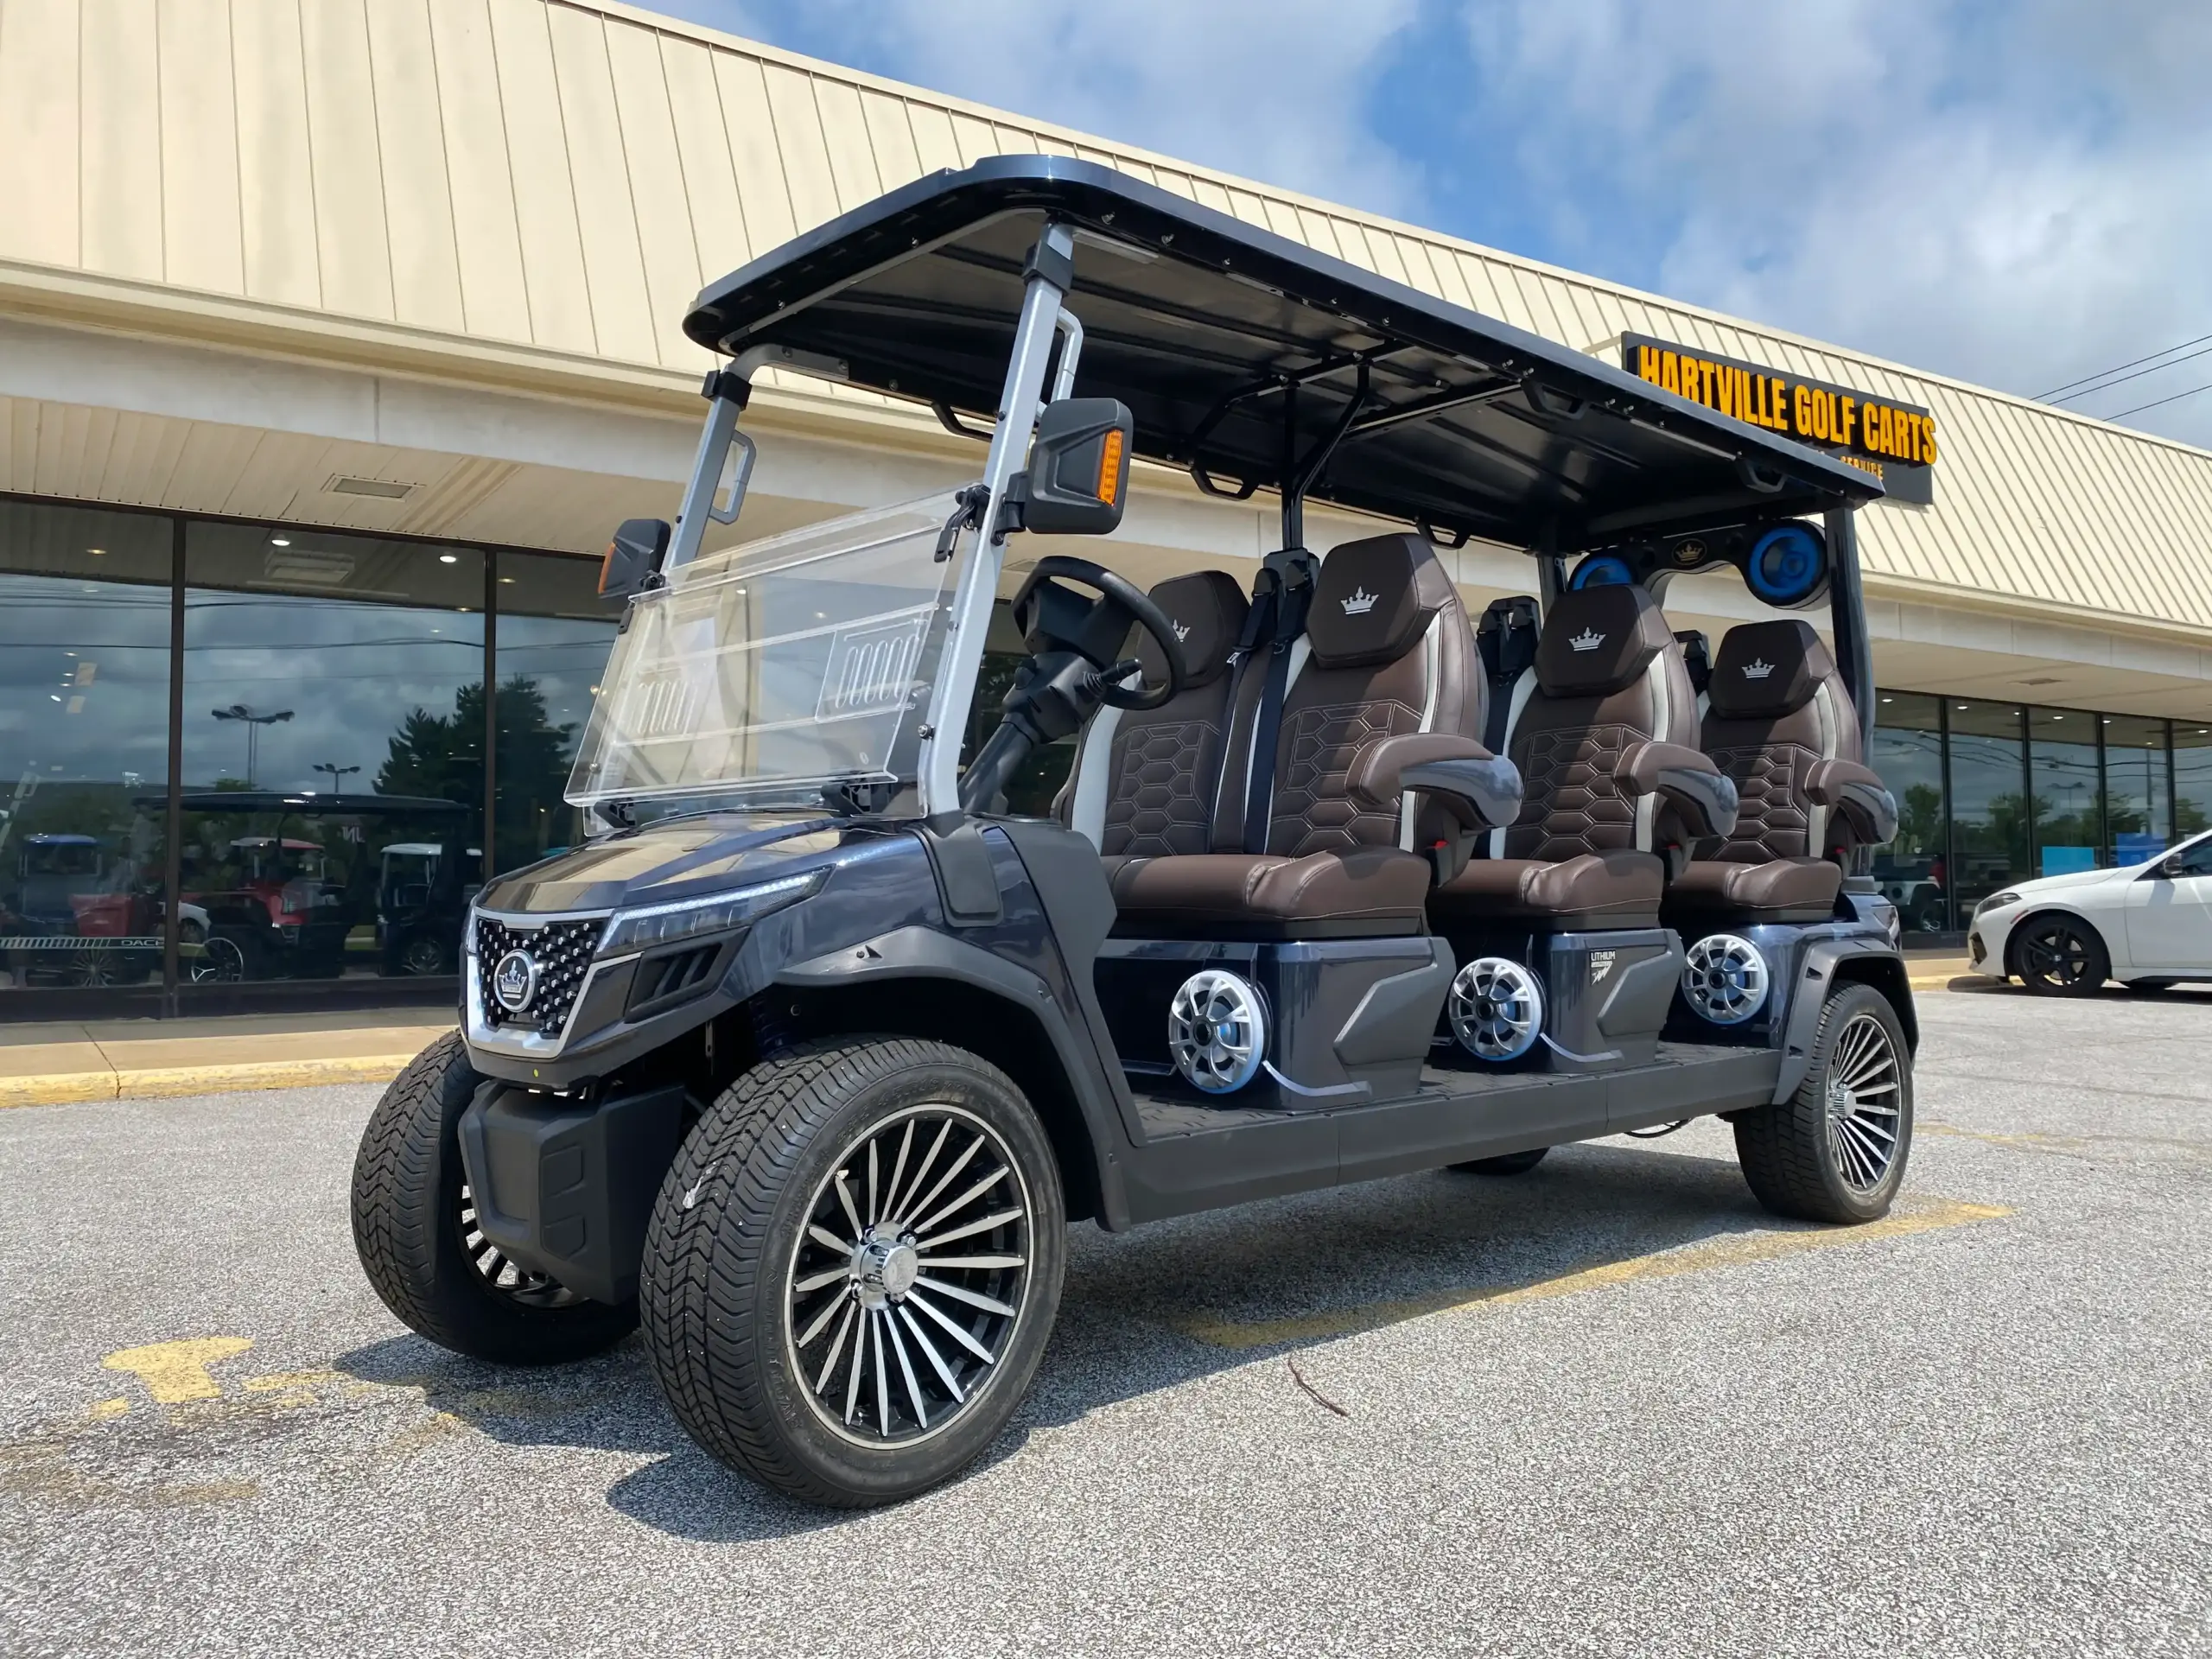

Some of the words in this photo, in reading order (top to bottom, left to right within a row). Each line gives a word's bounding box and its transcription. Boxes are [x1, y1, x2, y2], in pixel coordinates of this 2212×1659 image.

[1638, 345, 1789, 430] HARTVILLE
[1794, 385, 1856, 445] GOLF
[1863, 402, 1936, 465] CARTS
[1591, 950, 1616, 961] LITHIUM
